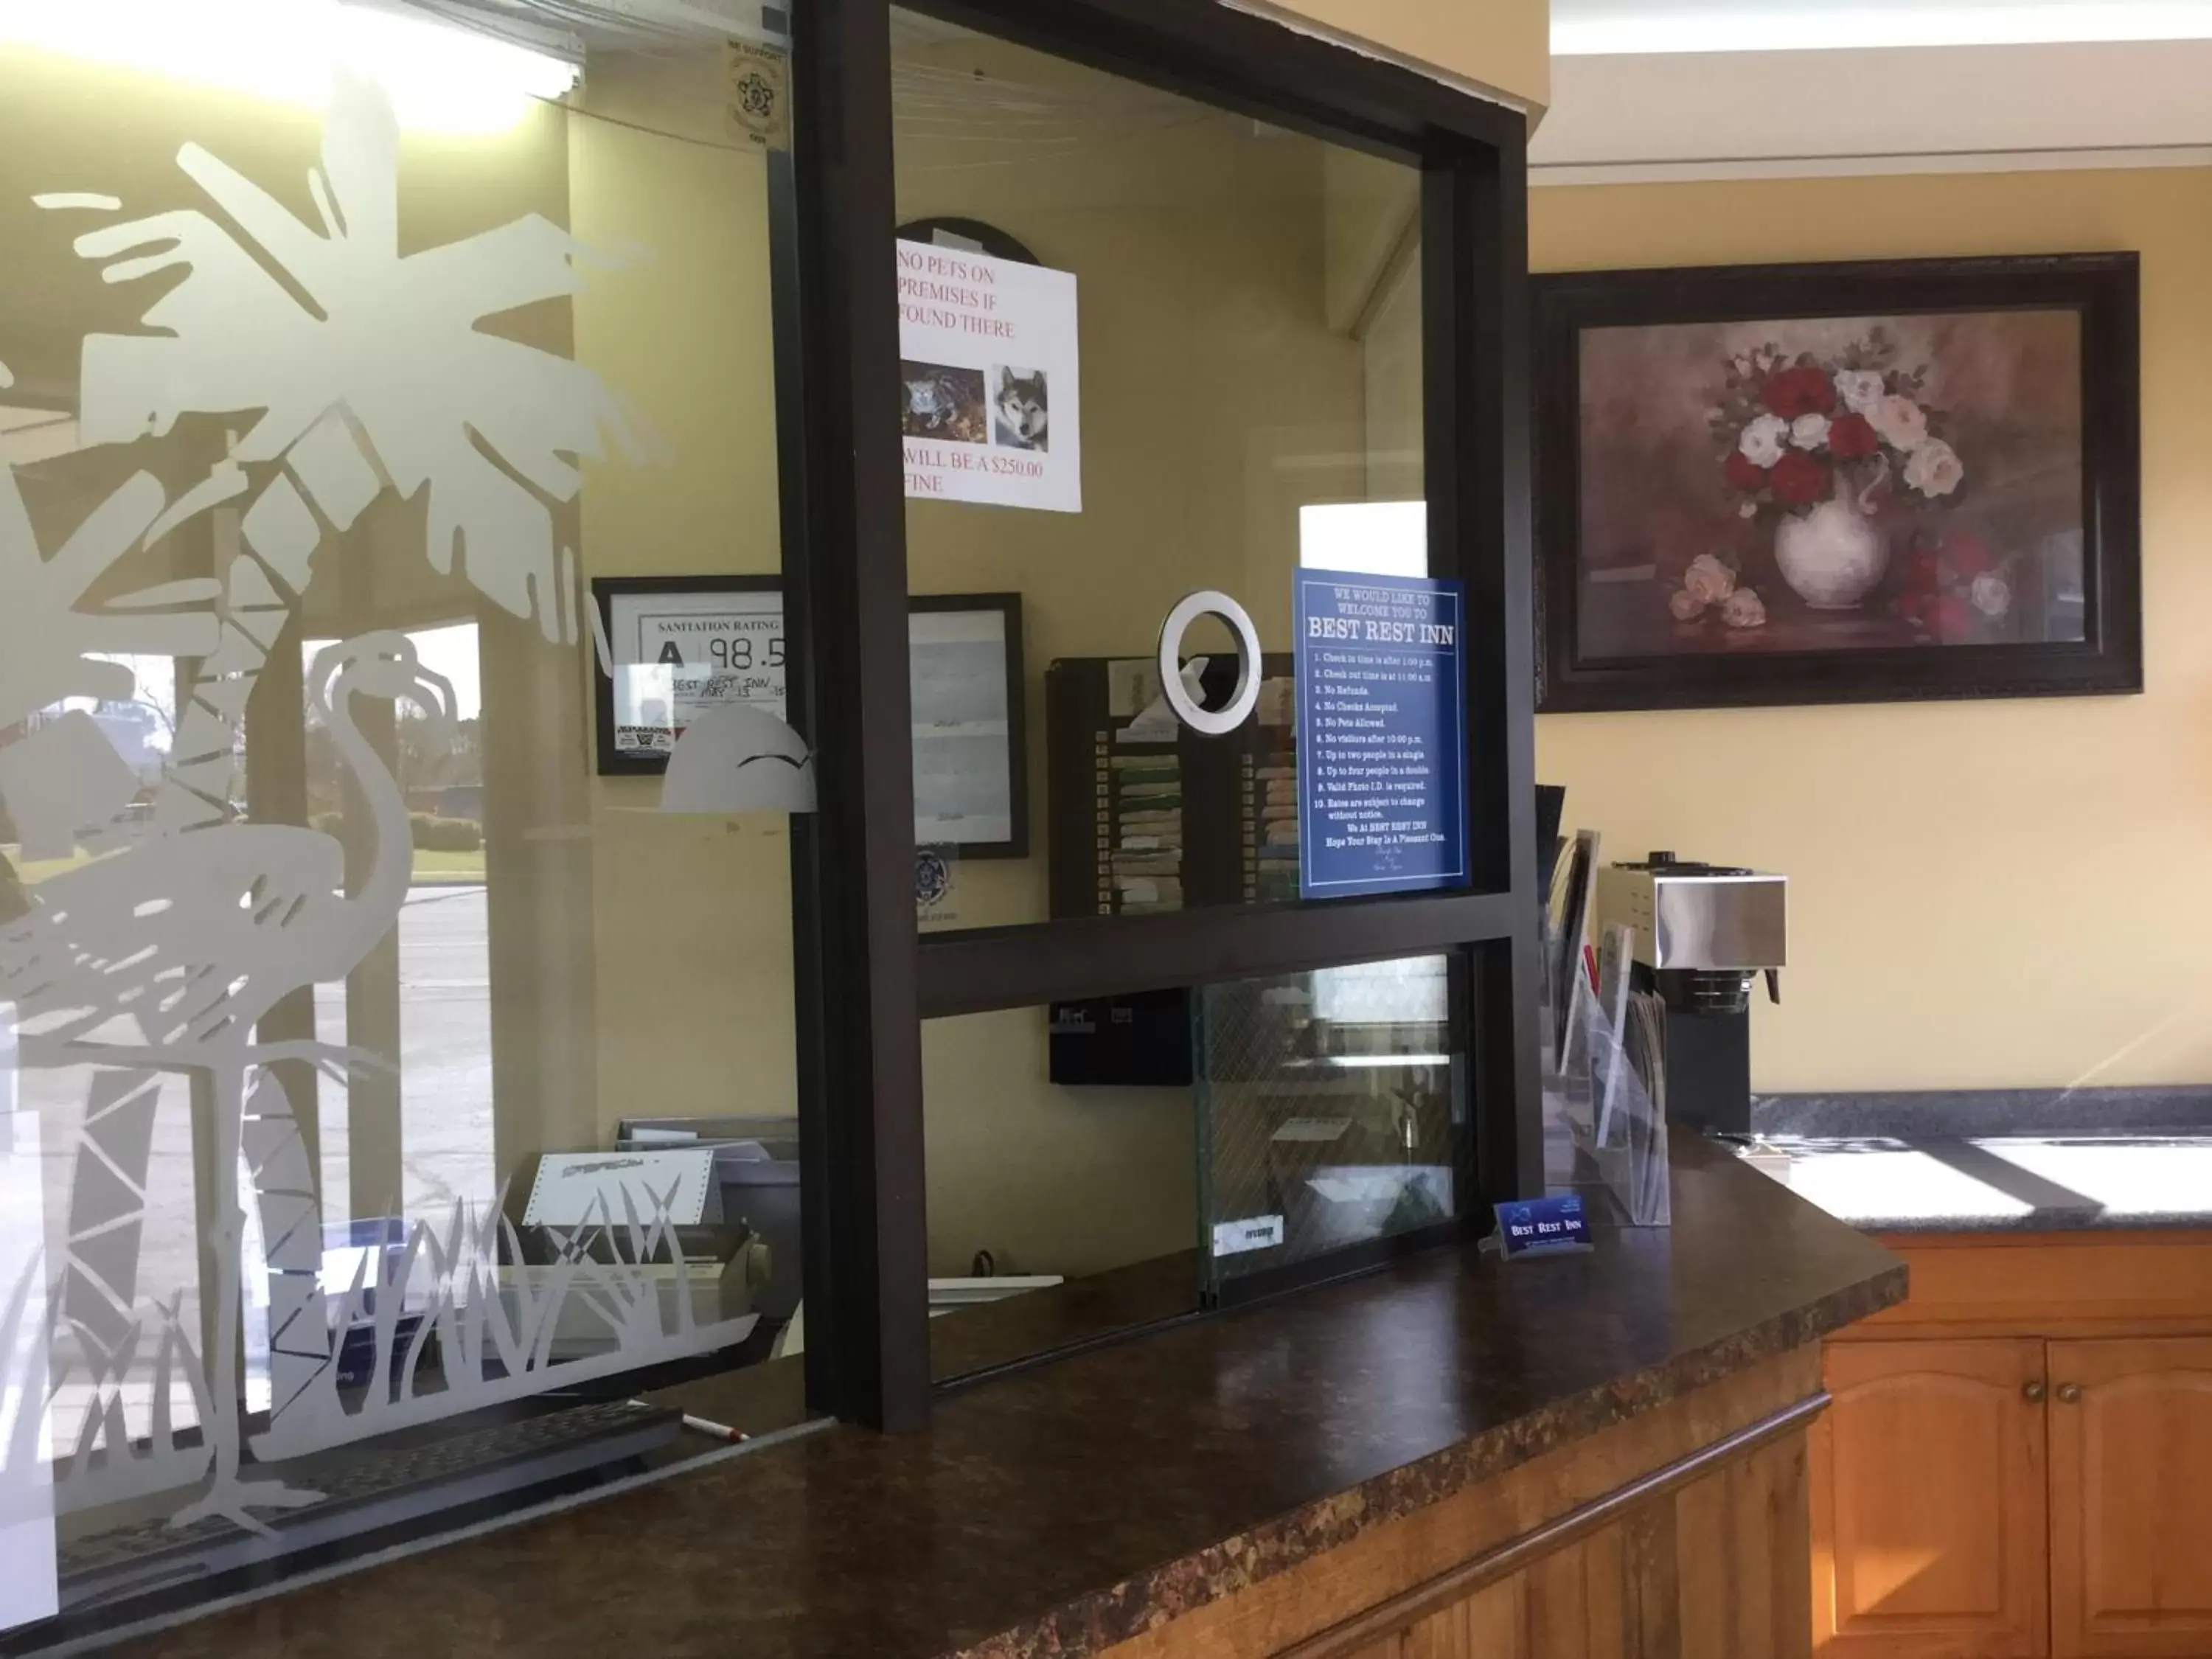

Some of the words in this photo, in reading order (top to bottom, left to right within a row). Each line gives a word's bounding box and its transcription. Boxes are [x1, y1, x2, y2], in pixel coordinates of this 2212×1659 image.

[897, 250, 922, 270] NO
[928, 256, 967, 279] PETS
[971, 265, 995, 284] ON
[899, 277, 978, 307] PREMISES
[984, 293, 998, 310] IF
[959, 315, 1015, 338] THERE
[903, 448, 947, 467] WILL
[951, 452, 974, 470] BE
[977, 457, 988, 472] A
[992, 456, 1043, 478] $250.00
[1334, 588, 1350, 599] WE
[1353, 589, 1389, 602] WOULD
[1391, 593, 1414, 604] LIKE
[1417, 594, 1430, 605] TO
[1338, 602, 1389, 616] WELCOME
[1391, 606, 1412, 619] YOU
[1414, 608, 1427, 620] TO
[658, 622, 730, 633] SANITATION
[734, 620, 779, 631] RATING
[1307, 616, 1360, 639] BEST
[1365, 619, 1415, 643] REST
[1420, 624, 1453, 644] INN
[658, 641, 684, 668] A
[710, 638, 787, 670] 98.5
[1324, 653, 1347, 663] Check
[1348, 655, 1356, 663] in
[1357, 654, 1374, 663] time
[1383, 655, 1400, 665] after
[1324, 669, 1346, 678] Check
[1349, 671, 1361, 679] out
[1363, 672, 1379, 680] time
[743, 677, 771, 688] INN
[1324, 685, 1335, 695] No
[1324, 701, 1335, 711] No
[1337, 702, 1363, 712] Checks
[1325, 717, 1336, 727] No
[1338, 718, 1354, 727] Pets
[1325, 734, 1336, 743] No
[1338, 734, 1366, 743] visitors
[1368, 734, 1385, 743] after
[1325, 751, 1337, 762] Up
[1338, 751, 1346, 759] to
[1347, 751, 1362, 759] two
[1363, 750, 1387, 761] people
[1388, 751, 1396, 759] in
[1326, 766, 1338, 778] Up
[1348, 767, 1364, 775] four
[1366, 767, 1389, 777] people
[1327, 782, 1346, 791] Valid
[1348, 782, 1369, 791] Photo
[1385, 782, 1392, 790] is
[1394, 782, 1426, 792] required.
[1327, 799, 1349, 808] Rates
[1364, 798, 1389, 808] subject
[1399, 798, 1425, 808] change
[1328, 811, 1357, 820] without
[1346, 824, 1358, 832] We
[1369, 822, 1389, 832] BEST
[1391, 821, 1411, 831] REST
[1412, 821, 1427, 830] INN
[1326, 837, 1345, 849] Hope
[1347, 837, 1365, 846] Your
[1366, 835, 1382, 846] Stay
[1392, 835, 1398, 844] A
[1399, 833, 1429, 843] Pleasant
[1512, 1225, 1534, 1236] BEST
[1537, 1222, 1561, 1233] REST
[1565, 1220, 1582, 1230] INN
